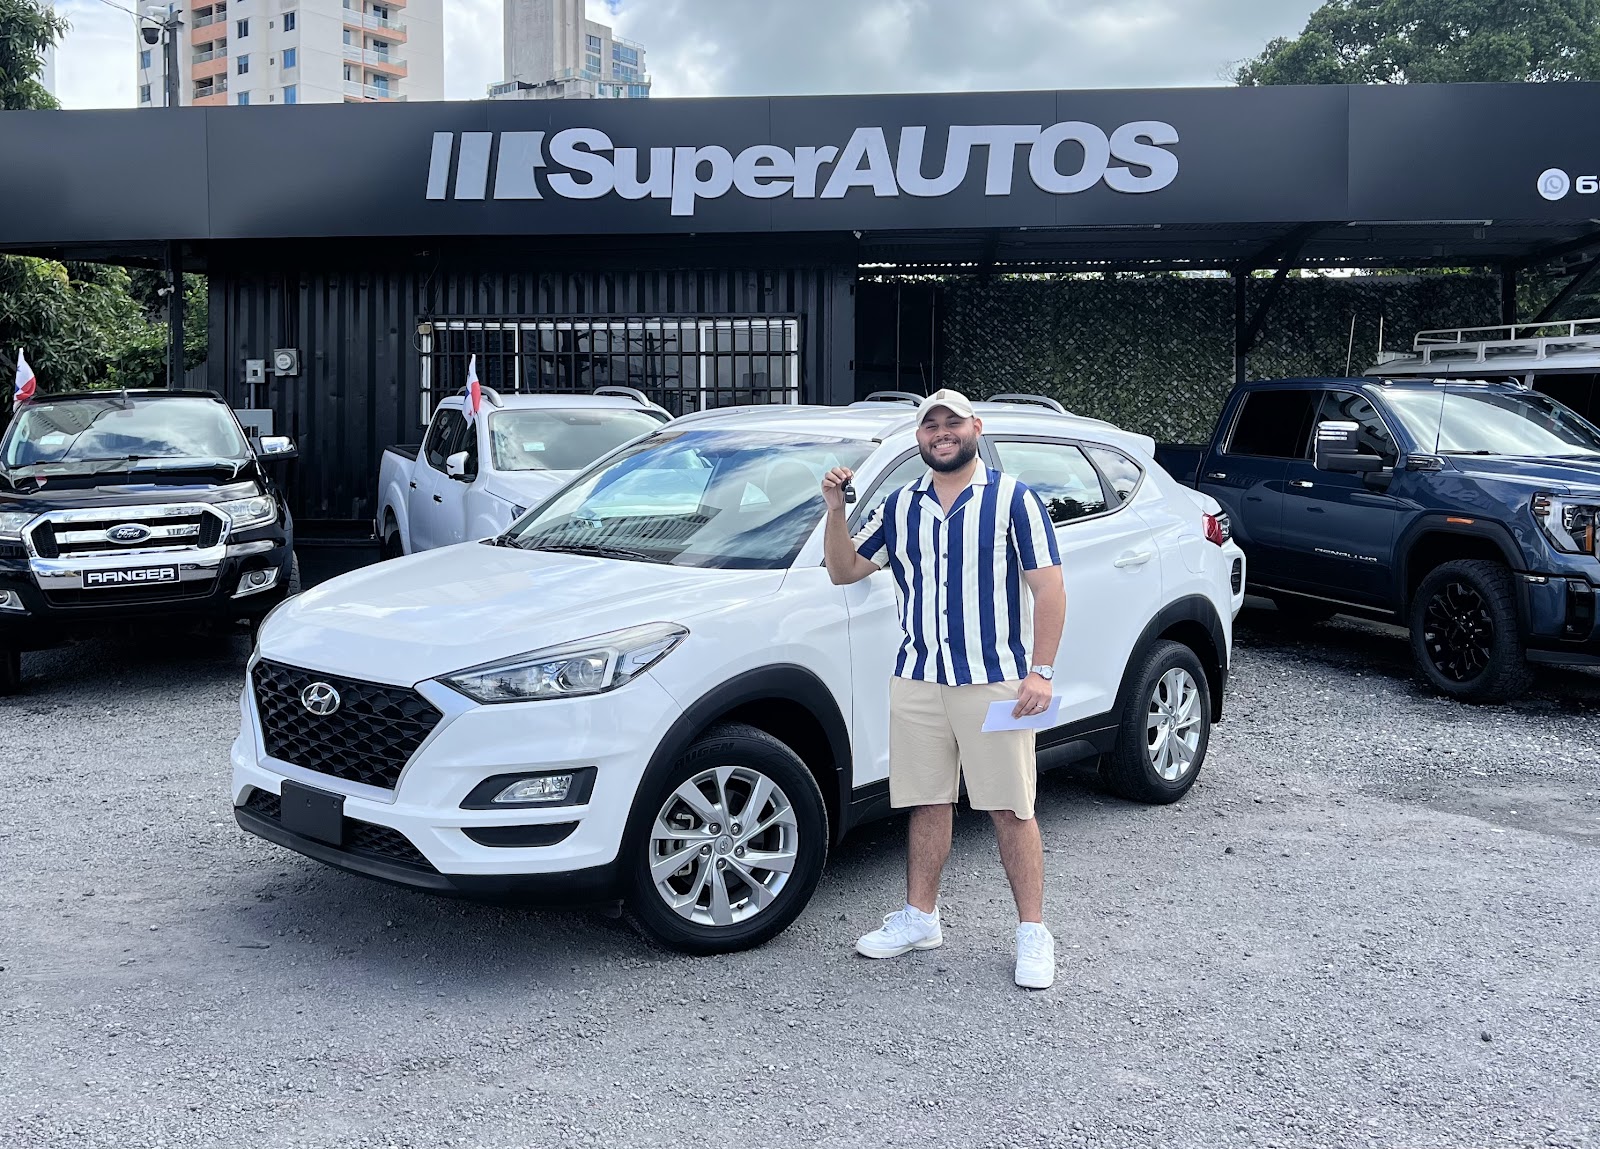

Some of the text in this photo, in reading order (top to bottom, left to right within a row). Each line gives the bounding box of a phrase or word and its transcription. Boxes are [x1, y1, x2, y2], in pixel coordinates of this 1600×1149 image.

[547, 120, 1180, 216] SuperAUTOS
[1575, 175, 1600, 194] 6
[117, 528, 140, 538] Ford
[88, 568, 175, 583] RANGER
